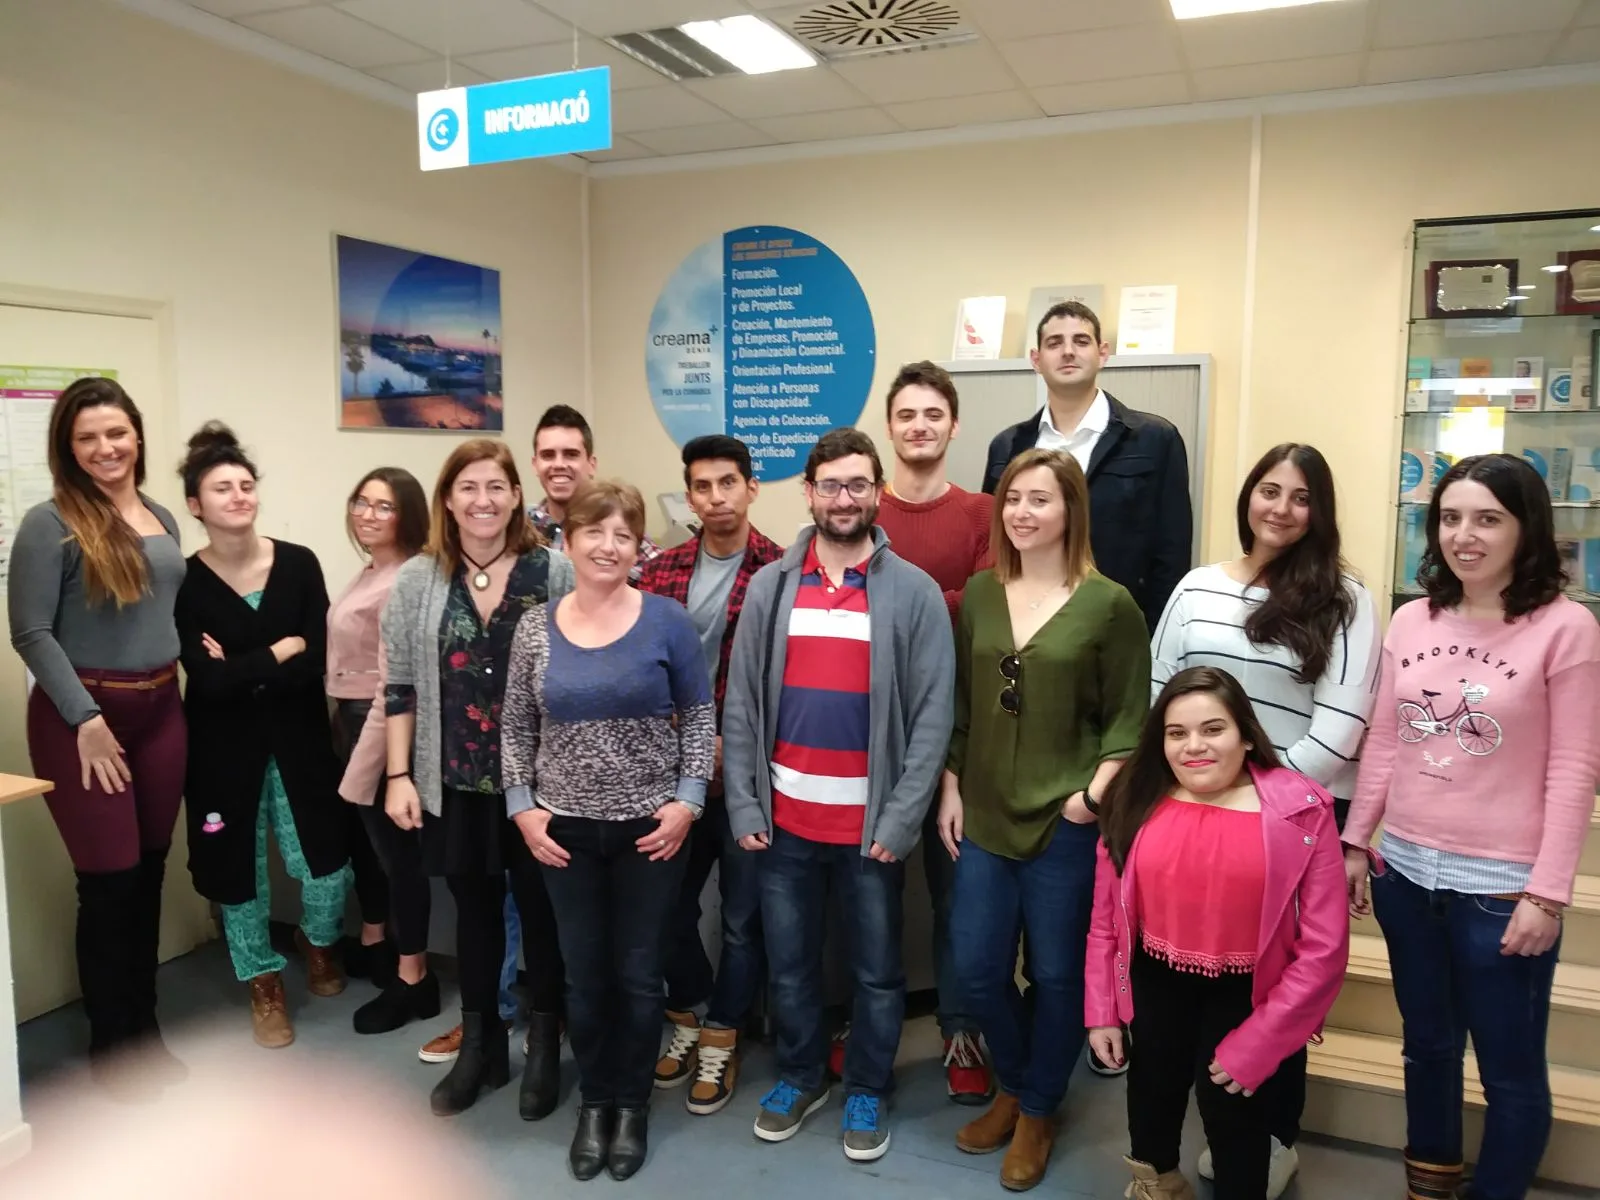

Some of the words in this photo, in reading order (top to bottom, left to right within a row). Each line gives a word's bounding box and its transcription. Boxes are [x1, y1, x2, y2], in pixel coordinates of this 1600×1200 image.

[484, 89, 590, 135] INFORMACIÓ
[732, 267, 779, 280] Formación.
[732, 286, 776, 298] Promoción
[778, 283, 803, 296] Local
[732, 304, 738, 315] y
[739, 301, 750, 312] de
[751, 300, 795, 313] Proyectos.
[732, 318, 772, 331] Creación,
[732, 333, 743, 345] de
[792, 330, 838, 342] Promoción
[732, 350, 738, 361] y
[798, 343, 846, 356] Comercial.
[732, 364, 781, 377] Orientación
[783, 362, 836, 375] Profesional.
[684, 372, 711, 384] JUNTS
[733, 383, 770, 395] Atención
[771, 386, 778, 394] a
[779, 382, 820, 394] Personas
[733, 399, 749, 408] con
[750, 396, 812, 410] Discapacidad.
[733, 415, 767, 428] Agencia
[768, 415, 780, 426] de
[781, 413, 833, 426] Colocación.
[760, 433, 771, 444] de
[772, 432, 819, 445] Expedición
[749, 446, 796, 458] Certificado
[1401, 645, 1518, 680] BROOKLYN
